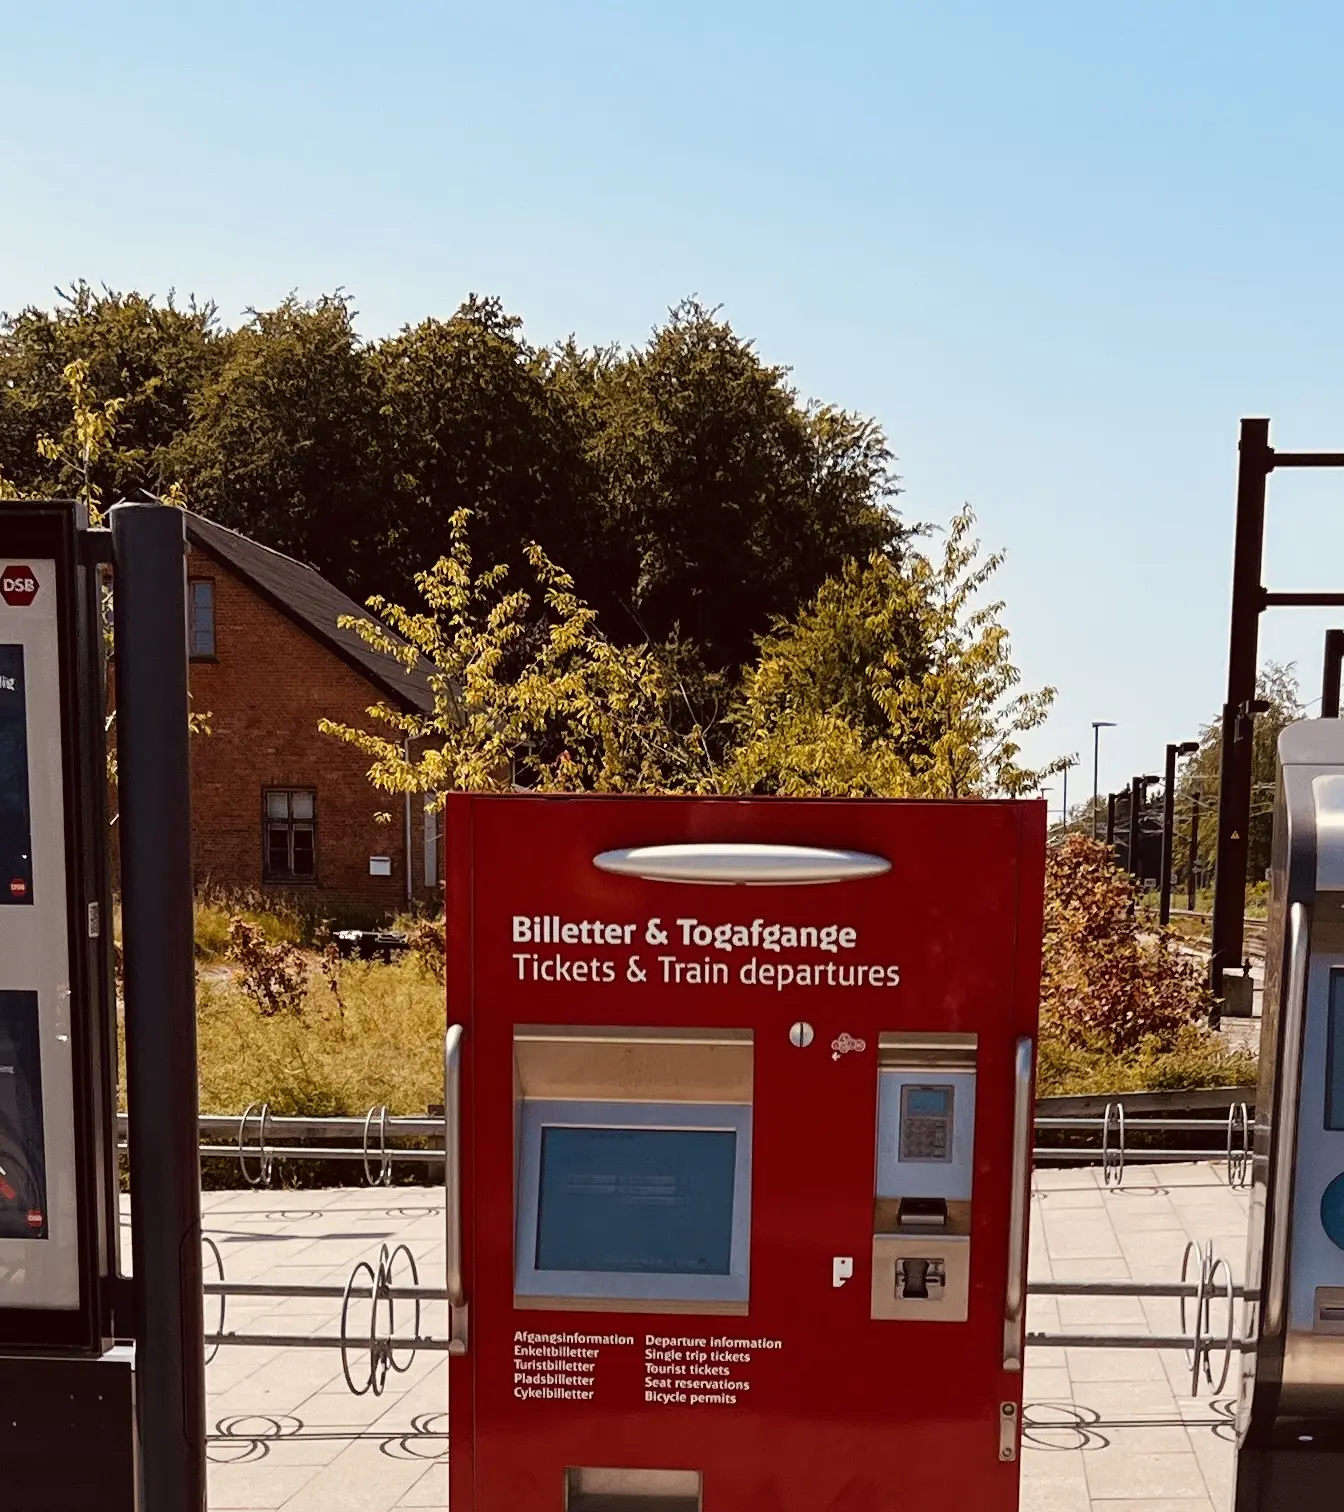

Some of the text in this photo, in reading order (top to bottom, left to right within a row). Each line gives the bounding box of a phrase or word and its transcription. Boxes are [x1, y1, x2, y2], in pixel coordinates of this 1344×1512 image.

[3, 578, 34, 592] DSB
[512, 916, 856, 953] Billetter & Togafgange
[514, 953, 899, 990] Tickets & Train departures
[514, 1331, 634, 1346] Afgangsinformation
[645, 1334, 782, 1349] Departure information
[514, 1346, 599, 1359] Enkeltbilletter
[645, 1348, 750, 1363] Single trip tickets
[514, 1359, 594, 1372] Turistbilletter
[645, 1362, 729, 1376] Tourist tickets
[514, 1373, 594, 1386] Pladsbilletter
[645, 1377, 750, 1391] Seat reservations
[514, 1387, 594, 1401] Cykelbilletter
[645, 1390, 736, 1405] Bicycle permits
